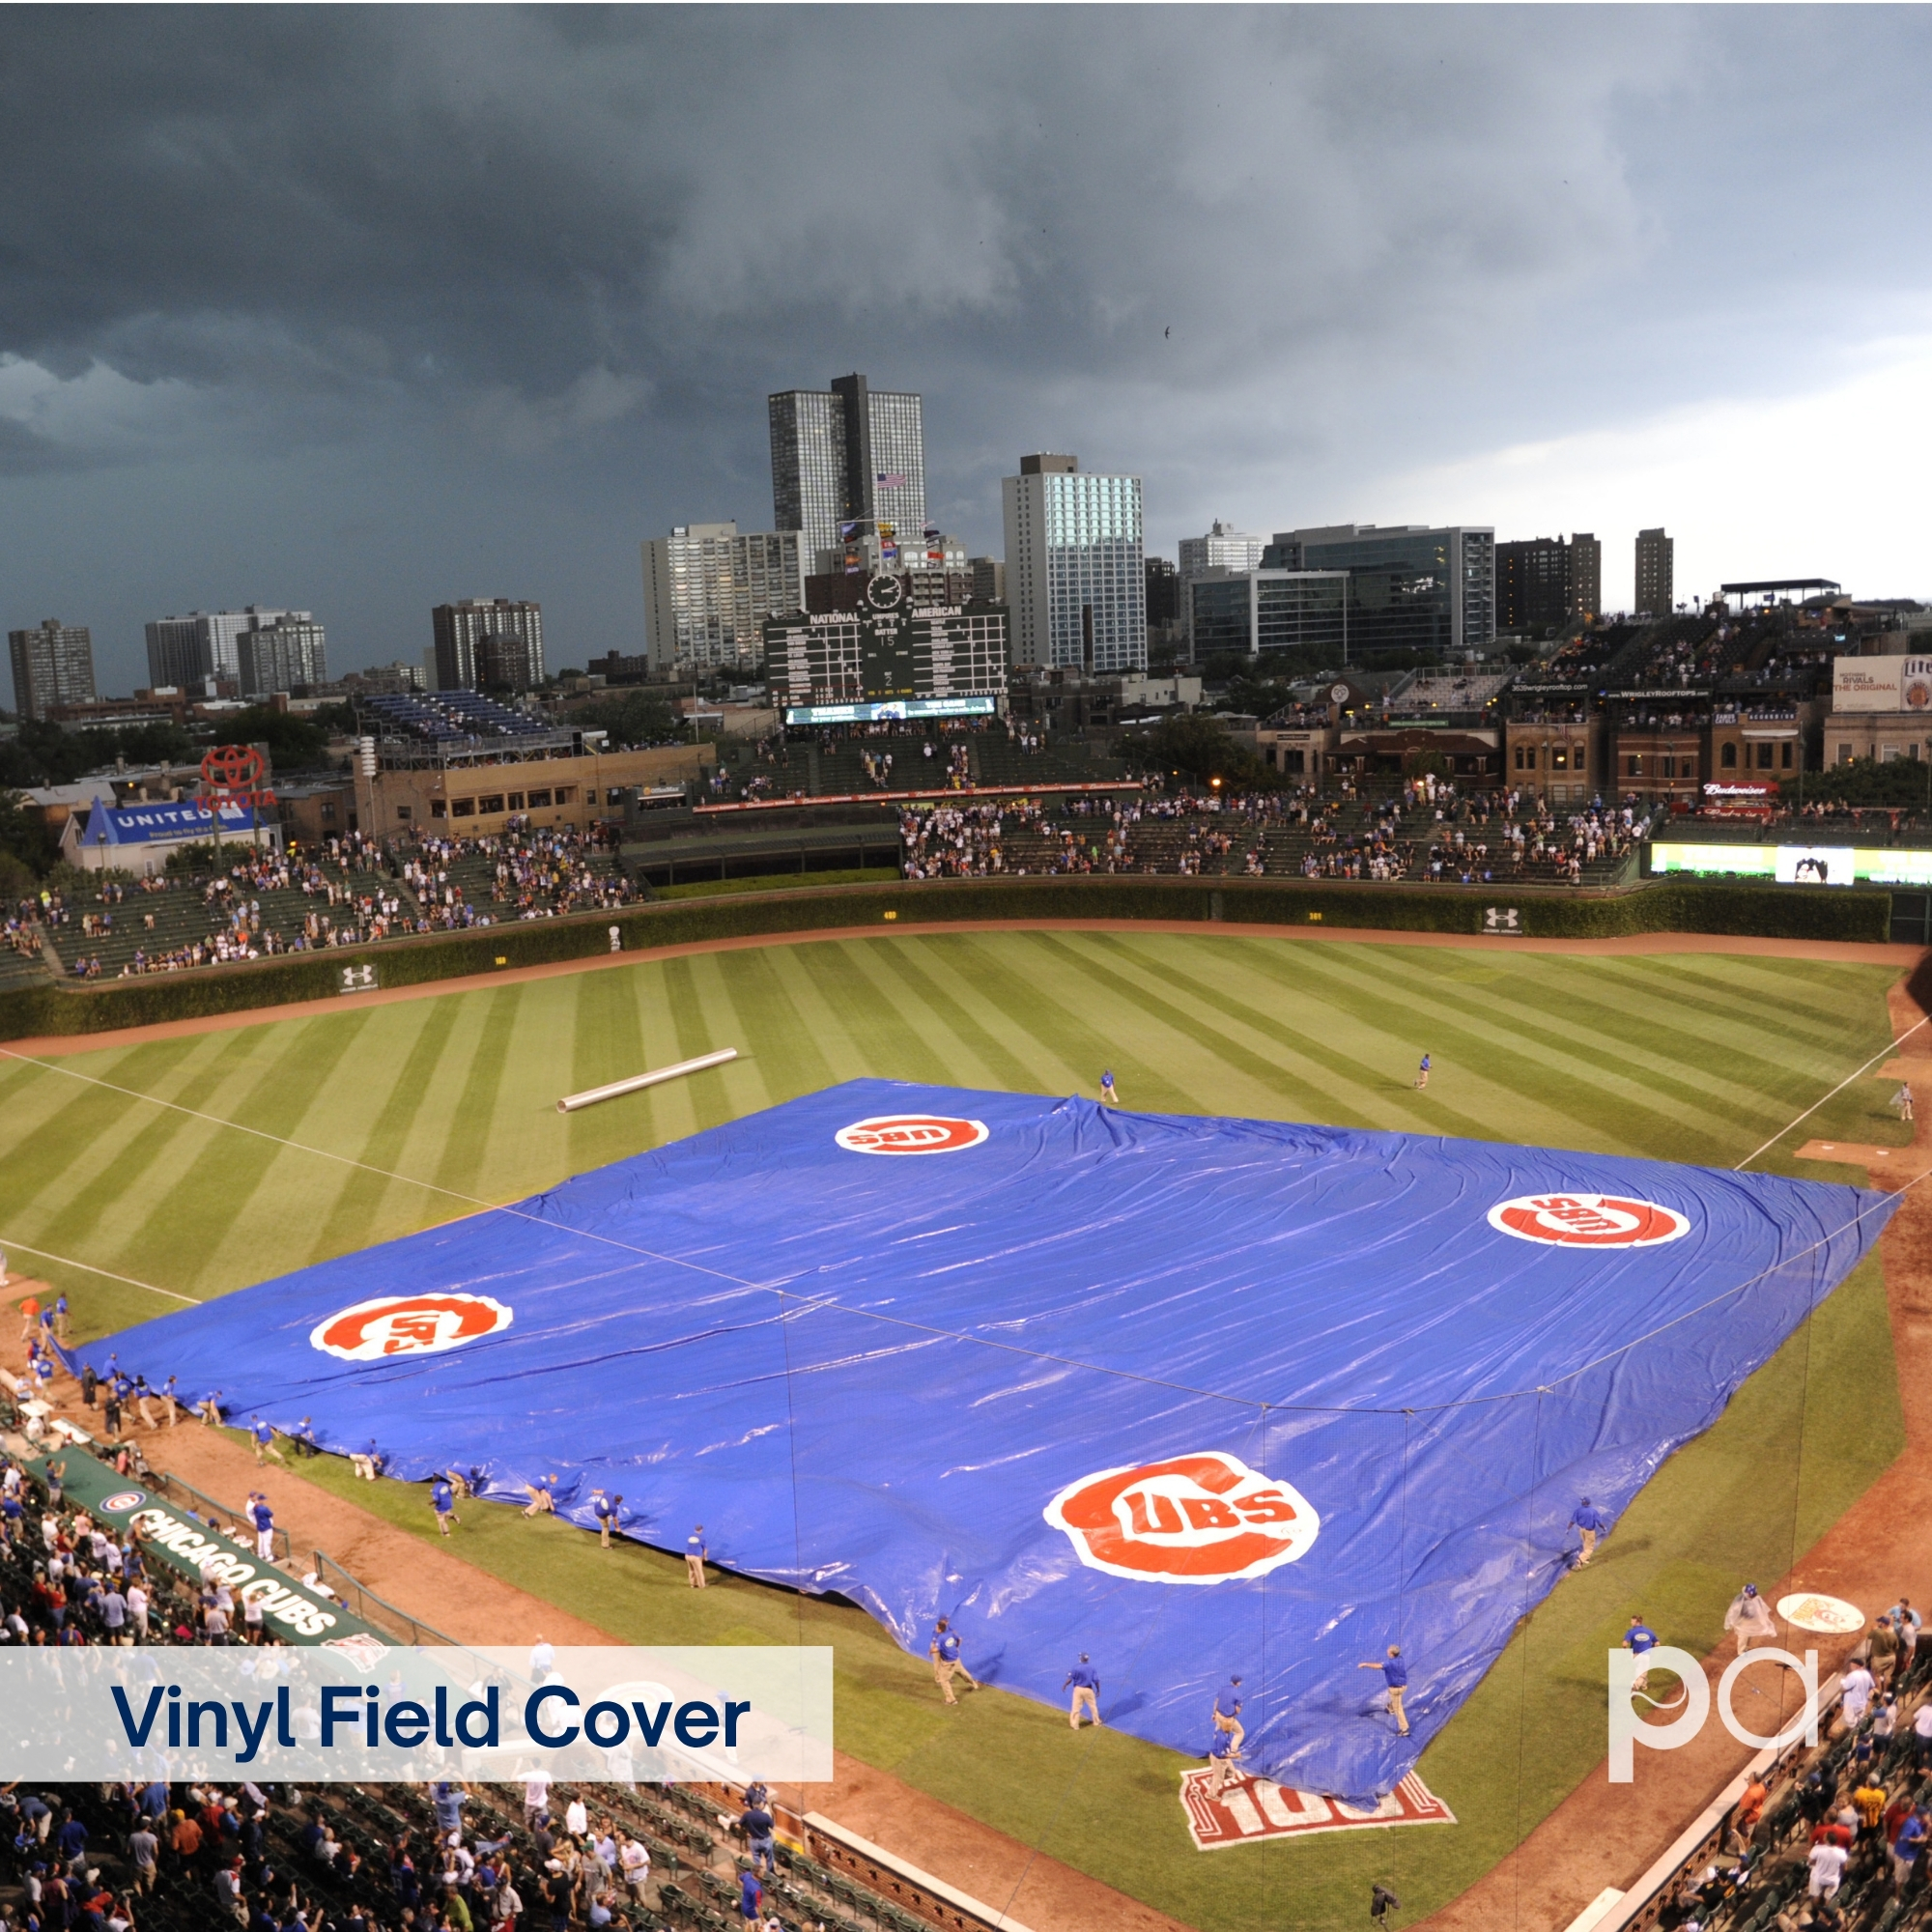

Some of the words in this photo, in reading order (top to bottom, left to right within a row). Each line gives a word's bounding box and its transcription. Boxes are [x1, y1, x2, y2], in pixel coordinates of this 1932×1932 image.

[810, 611, 861, 625] NATIONAL
[911, 606, 962, 618] AMERICAN
[881, 636, 895, 646] 15
[1854, 683, 1897, 692] ORIGINAL
[1703, 783, 1767, 795] Budweiser
[193, 789, 278, 813] TOYOTA
[117, 808, 213, 828] UNITED
[1060, 1456, 1298, 1577] CUBS
[128, 1508, 256, 1585] CHICAGO
[242, 1577, 337, 1636] CUBS
